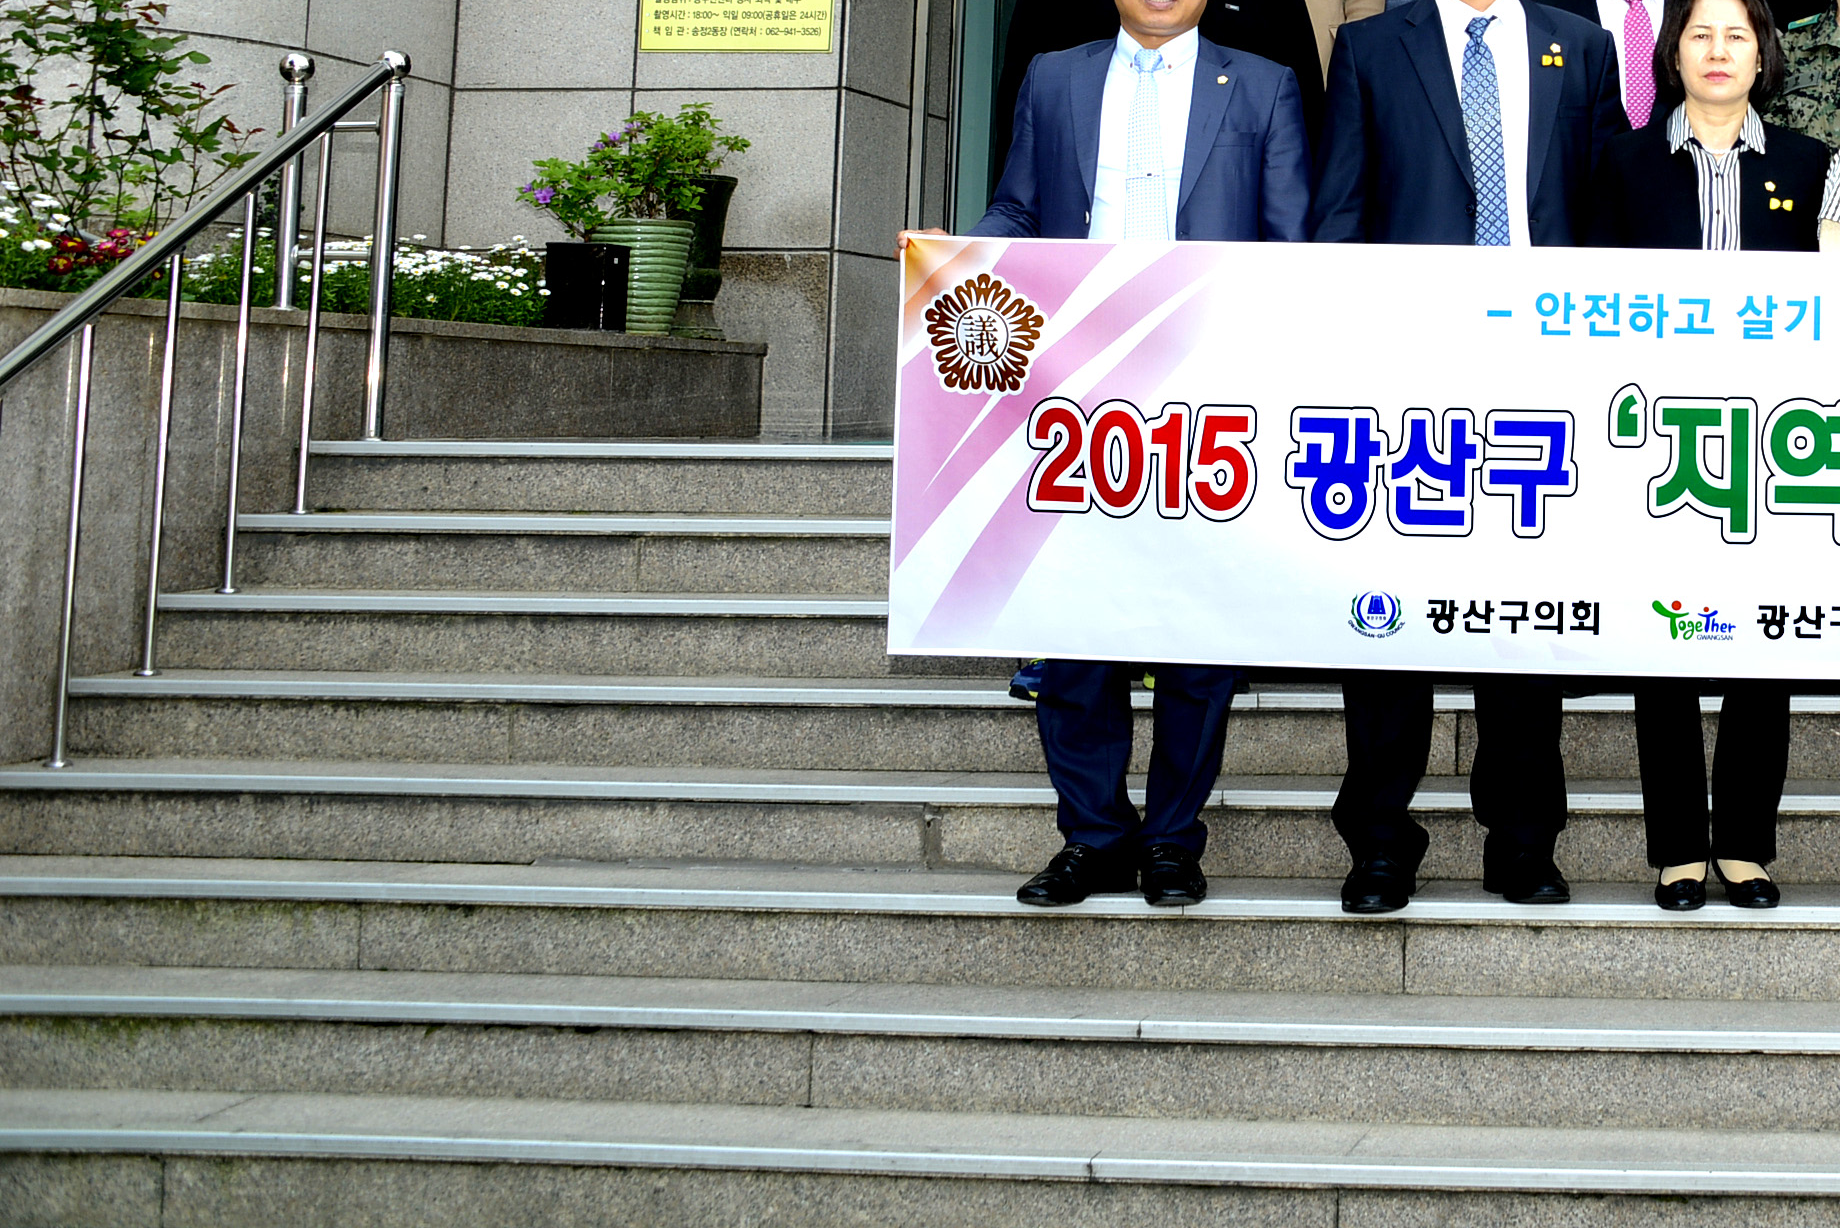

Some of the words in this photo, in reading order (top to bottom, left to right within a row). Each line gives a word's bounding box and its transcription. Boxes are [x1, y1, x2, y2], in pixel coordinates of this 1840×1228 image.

[653, 9, 686, 20] 촬영시간
[691, 25, 728, 37] 송정2동장
[962, 314, 999, 359] 議
[1534, 292, 1715, 339] 안전하고
[1736, 293, 1823, 341] 살기
[1032, 405, 1252, 514] 2015
[1292, 414, 1571, 531] 광산구
[1425, 598, 1600, 636] 광산구의회
